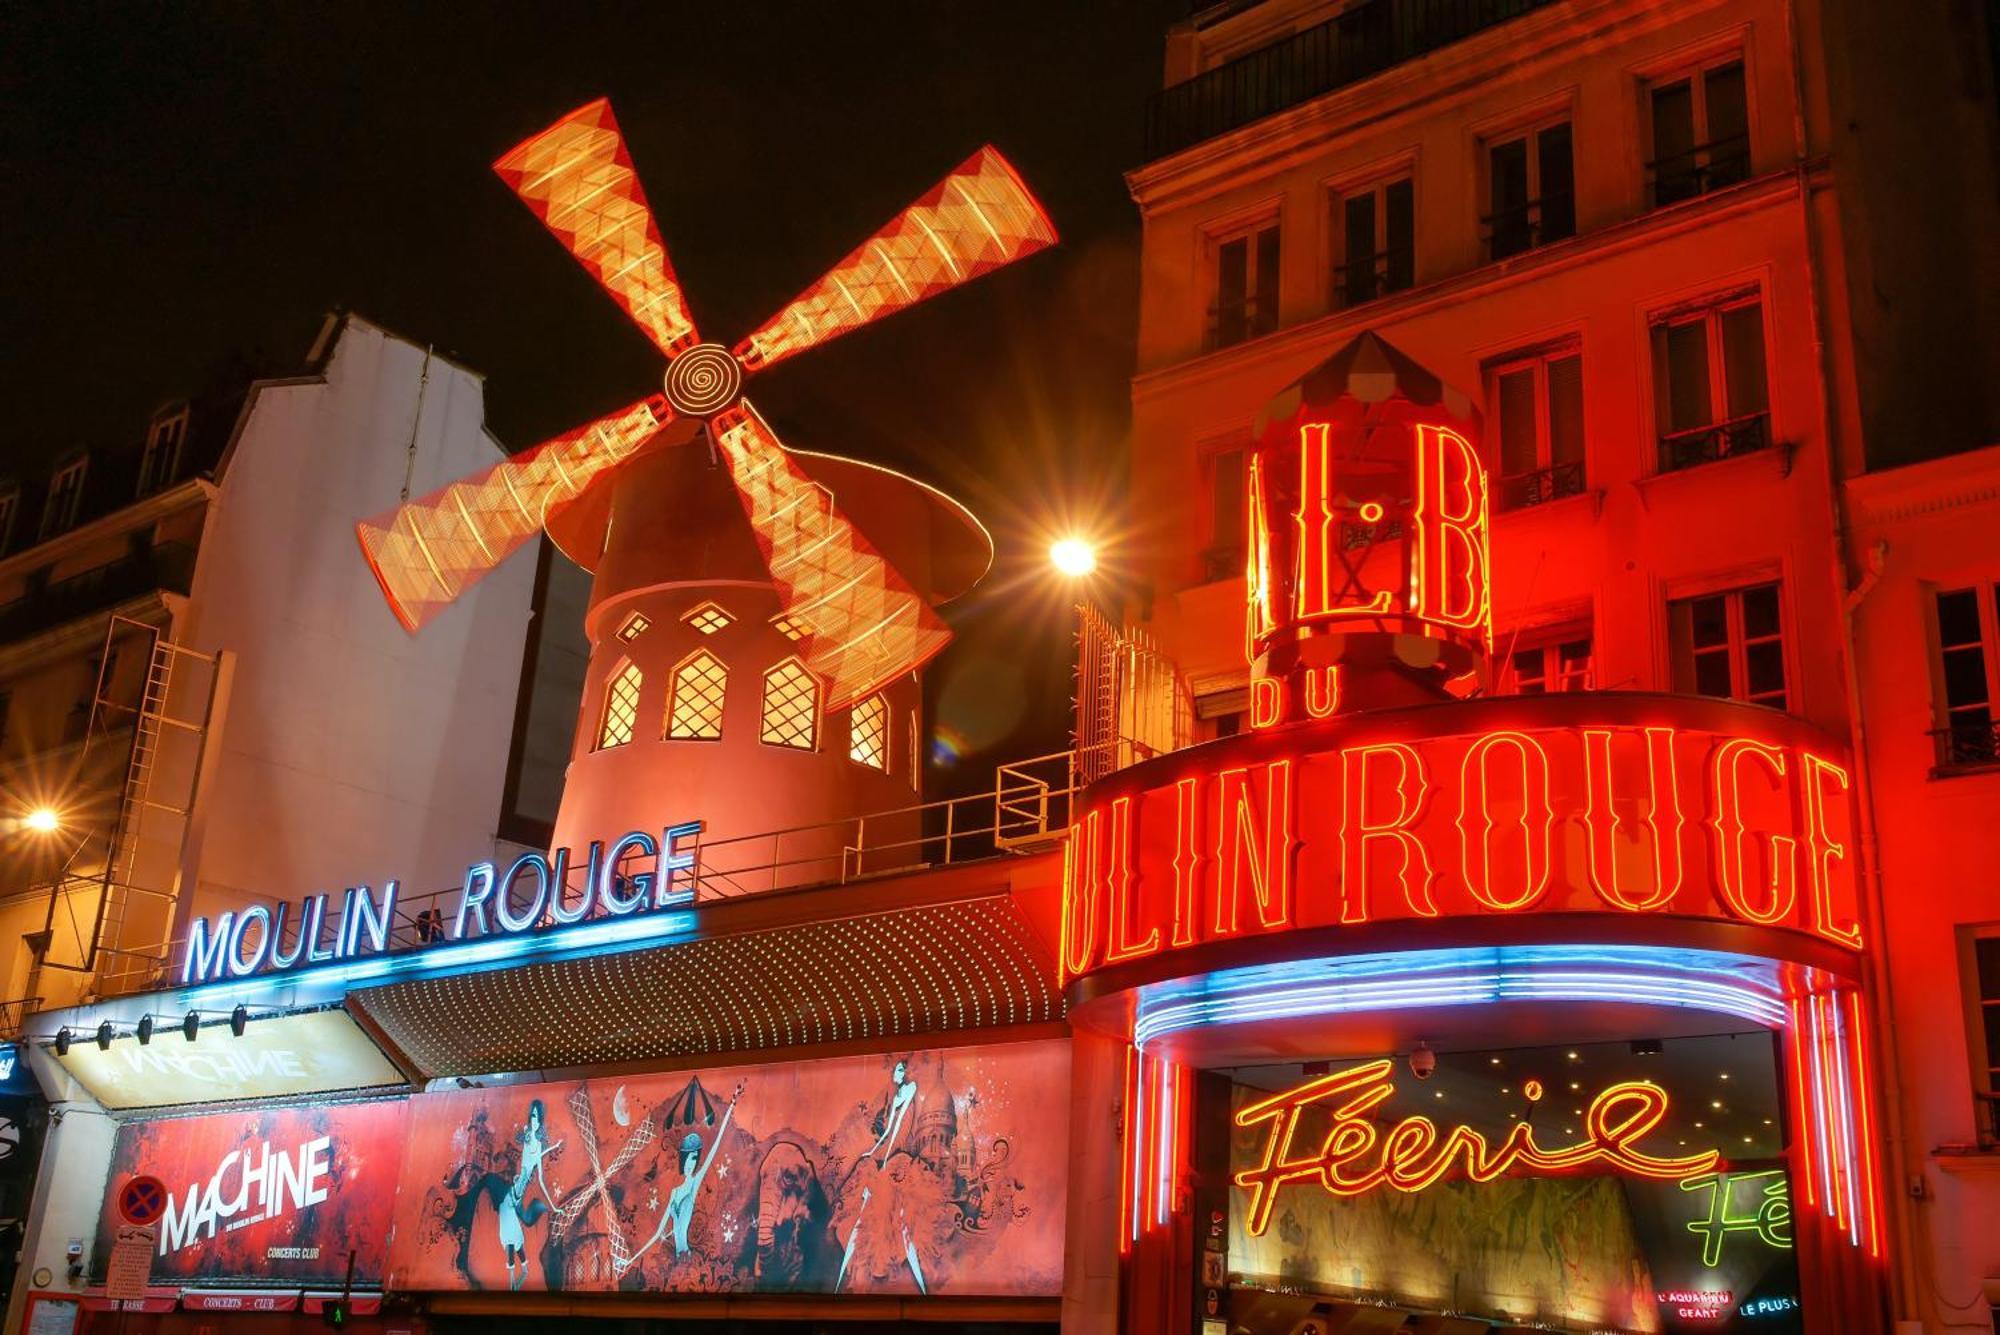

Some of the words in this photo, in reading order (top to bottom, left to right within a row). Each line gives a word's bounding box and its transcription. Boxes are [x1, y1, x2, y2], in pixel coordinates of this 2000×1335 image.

[1250, 666, 1338, 728] DU
[182, 880, 400, 984] MOULIN
[453, 820, 707, 940] ROUGE
[1059, 759, 1300, 989] ULIN
[1339, 727, 1864, 950] ROUGE
[1235, 1058, 1721, 1237] Féerie
[159, 1135, 330, 1257] MACHINE
[267, 1247, 301, 1259] CONCERTS
[302, 1247, 320, 1259] CLUB
[254, 1297, 275, 1310] CLUB
[1740, 1305, 1755, 1316] LE
[1759, 1299, 1791, 1313] PLUS
